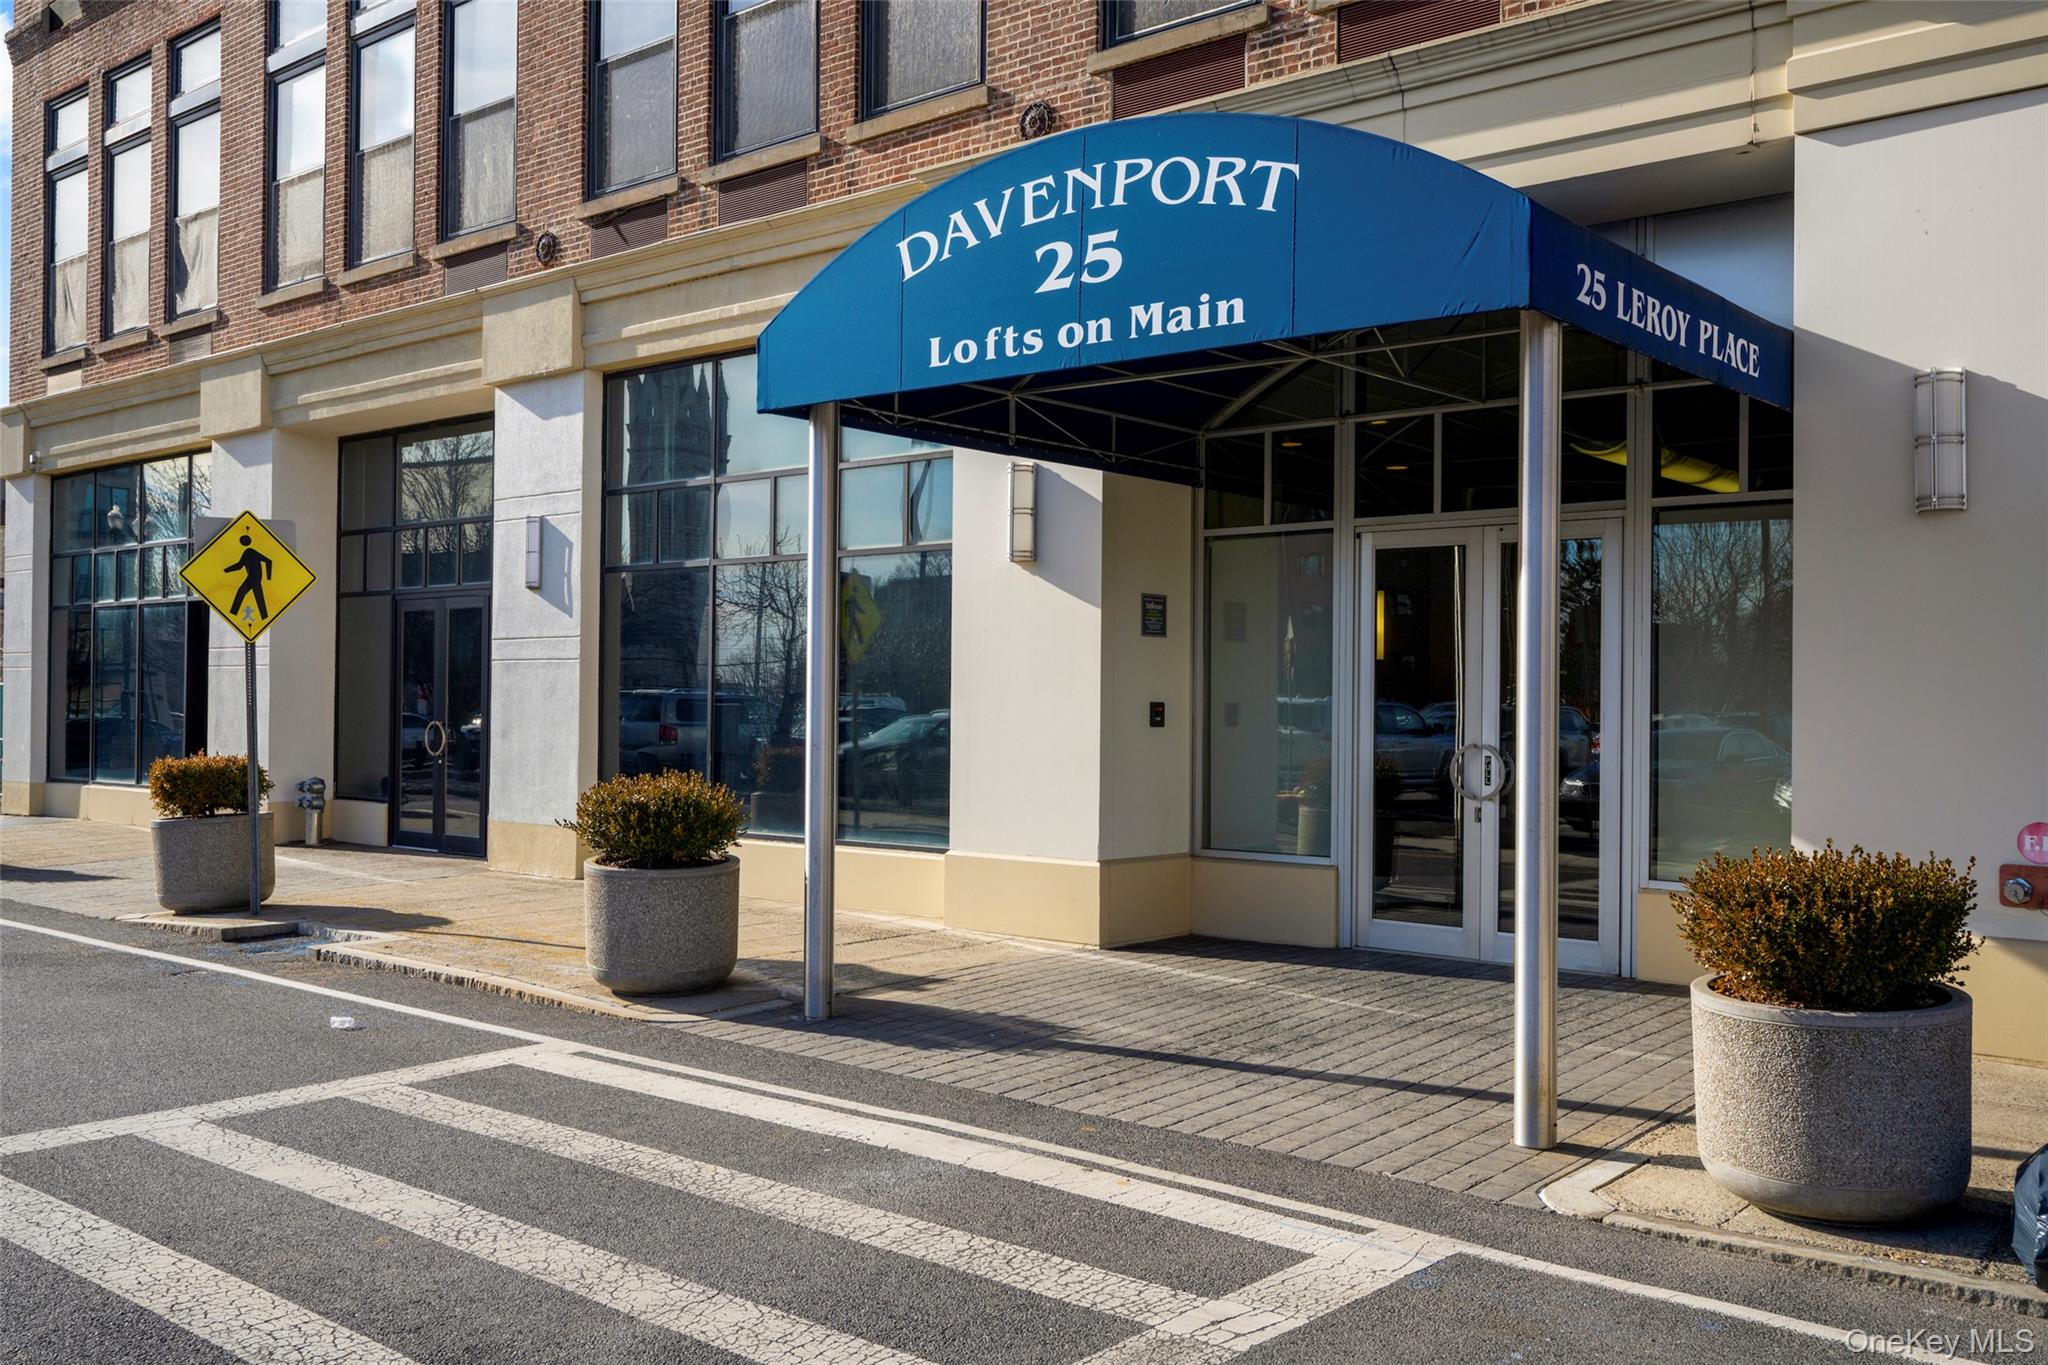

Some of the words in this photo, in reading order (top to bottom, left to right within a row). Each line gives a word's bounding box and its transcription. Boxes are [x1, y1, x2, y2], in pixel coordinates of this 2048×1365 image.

[896, 156, 1300, 282] DAVENPORT
[1034, 229, 1123, 294] 25
[929, 325, 1044, 368] Lofts
[1057, 317, 1113, 348] on
[1129, 293, 1246, 339] Main
[1576, 263, 1607, 311] 25
[1616, 281, 1691, 348] LEROY
[1698, 319, 1760, 378] PLACE
